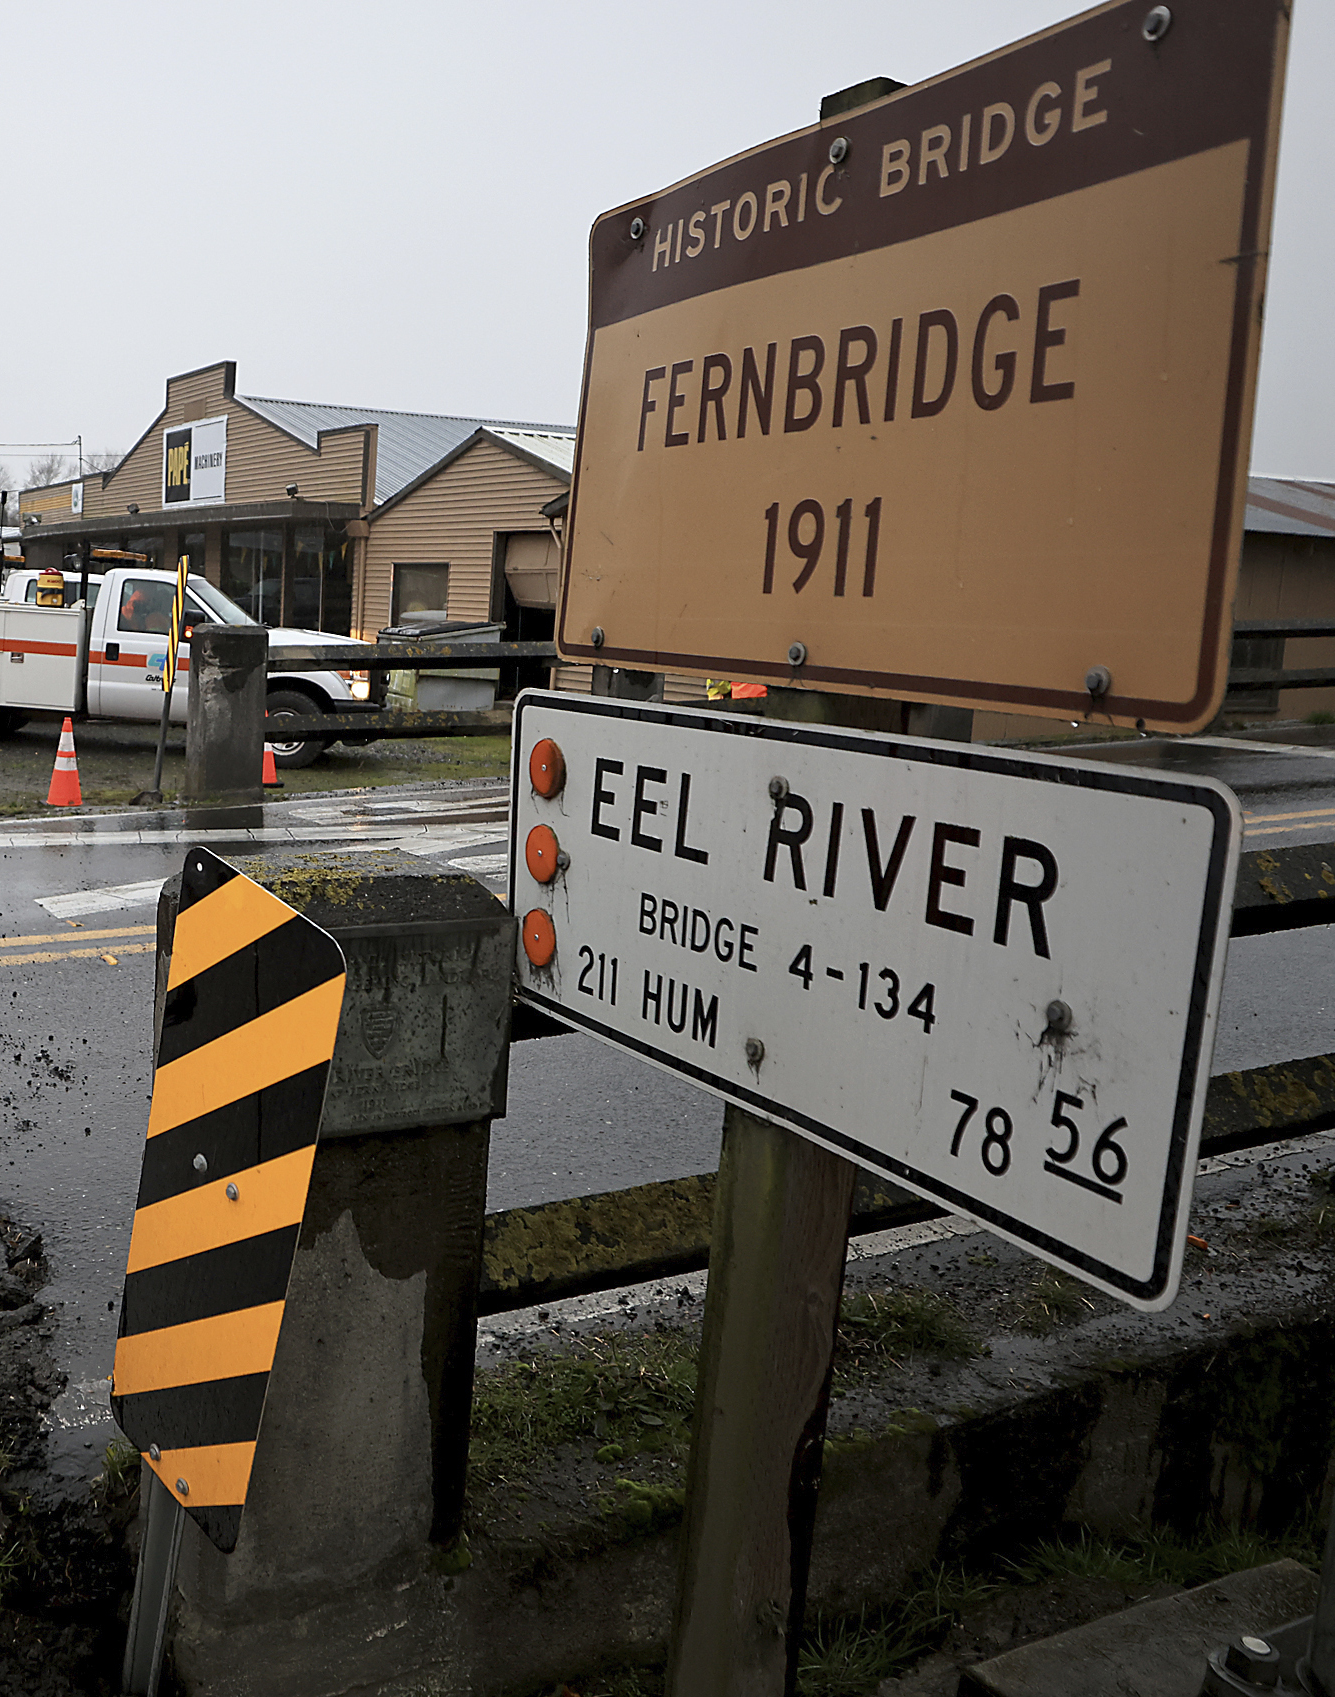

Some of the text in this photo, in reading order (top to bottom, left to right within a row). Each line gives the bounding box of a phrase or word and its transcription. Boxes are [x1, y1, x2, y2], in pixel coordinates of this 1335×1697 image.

[651, 58, 1113, 273] HISTORIC BRIDGE
[636, 278, 1081, 453] FERNBRIDGE
[194, 452, 224, 470] MACHINERY
[762, 496, 883, 599] 1911
[591, 757, 1060, 961] EEL RIVER
[577, 944, 618, 1007] 211
[642, 969, 719, 1050] HUM
[639, 892, 936, 1035] BRIDGE 4-134
[949, 1088, 1129, 1187] 78 56
